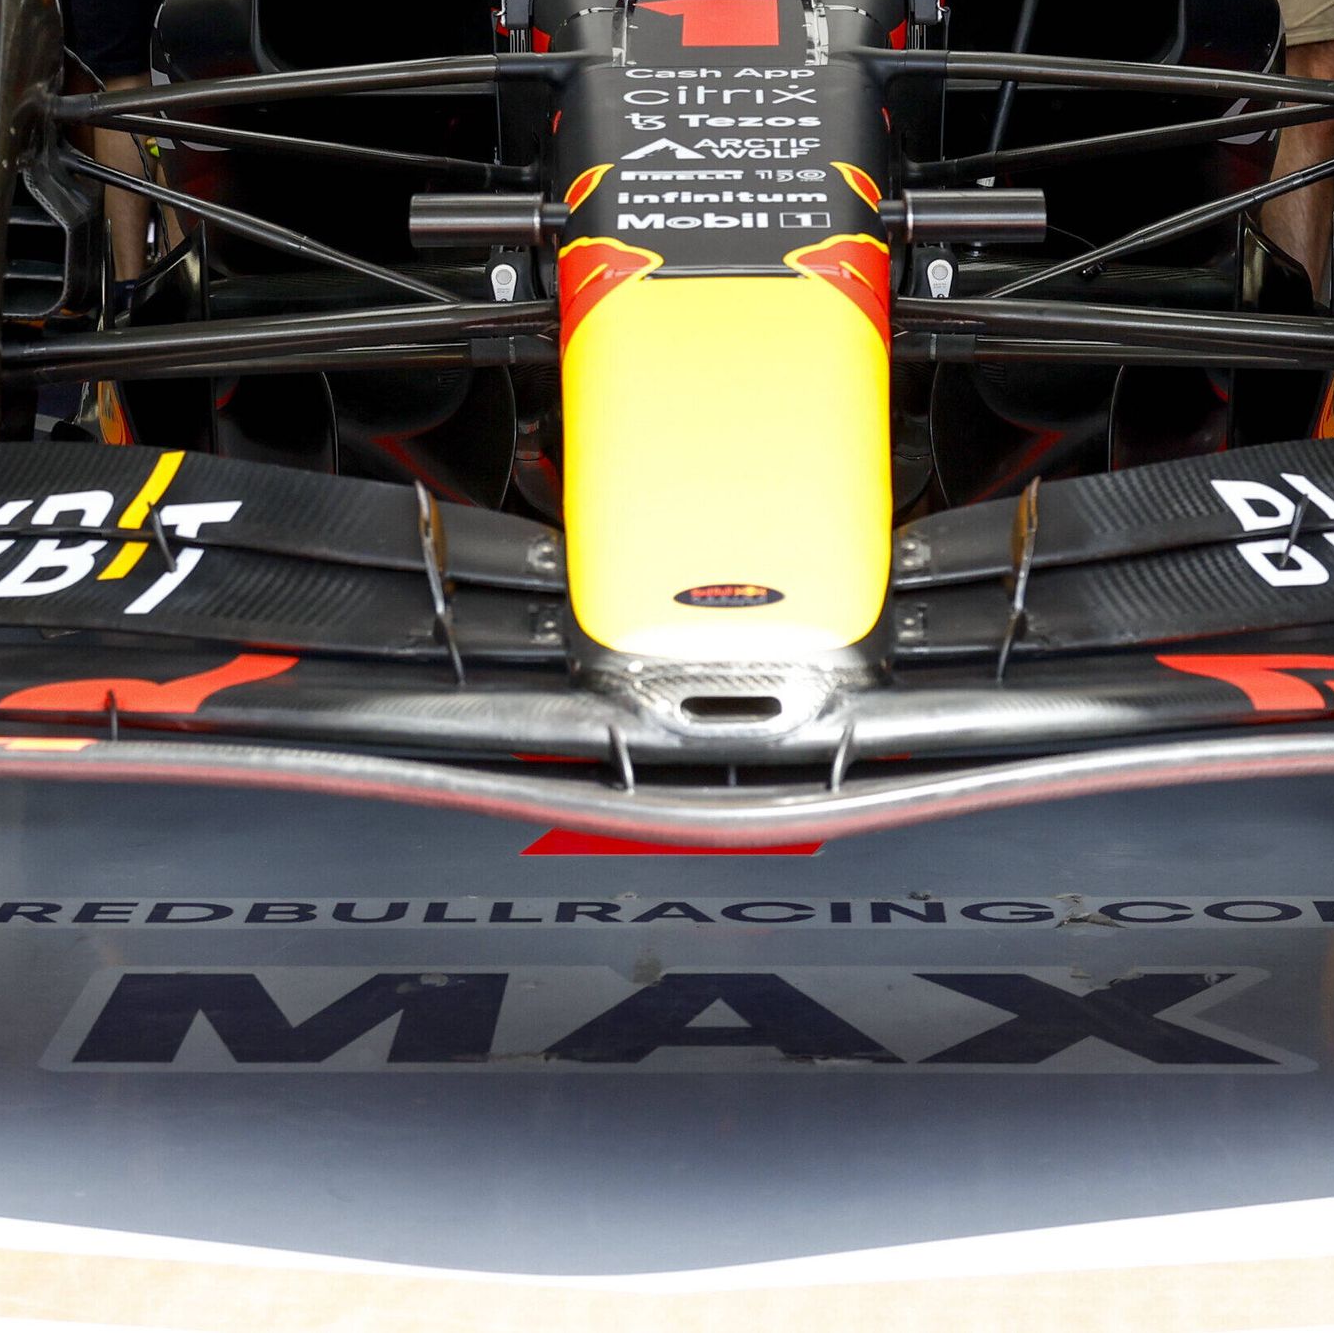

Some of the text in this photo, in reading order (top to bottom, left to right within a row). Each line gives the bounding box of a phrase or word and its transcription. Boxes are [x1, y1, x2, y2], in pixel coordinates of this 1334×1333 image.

[625, 68, 816, 79] Cash App
[679, 114, 822, 127] Tezos
[693, 137, 822, 148] ARCTIC
[710, 148, 811, 159] WOLF
[620, 170, 745, 181] PIRELLI
[617, 191, 828, 204] infinitum
[617, 212, 769, 230] Mobil
[72, 972, 1284, 1065] MAX
